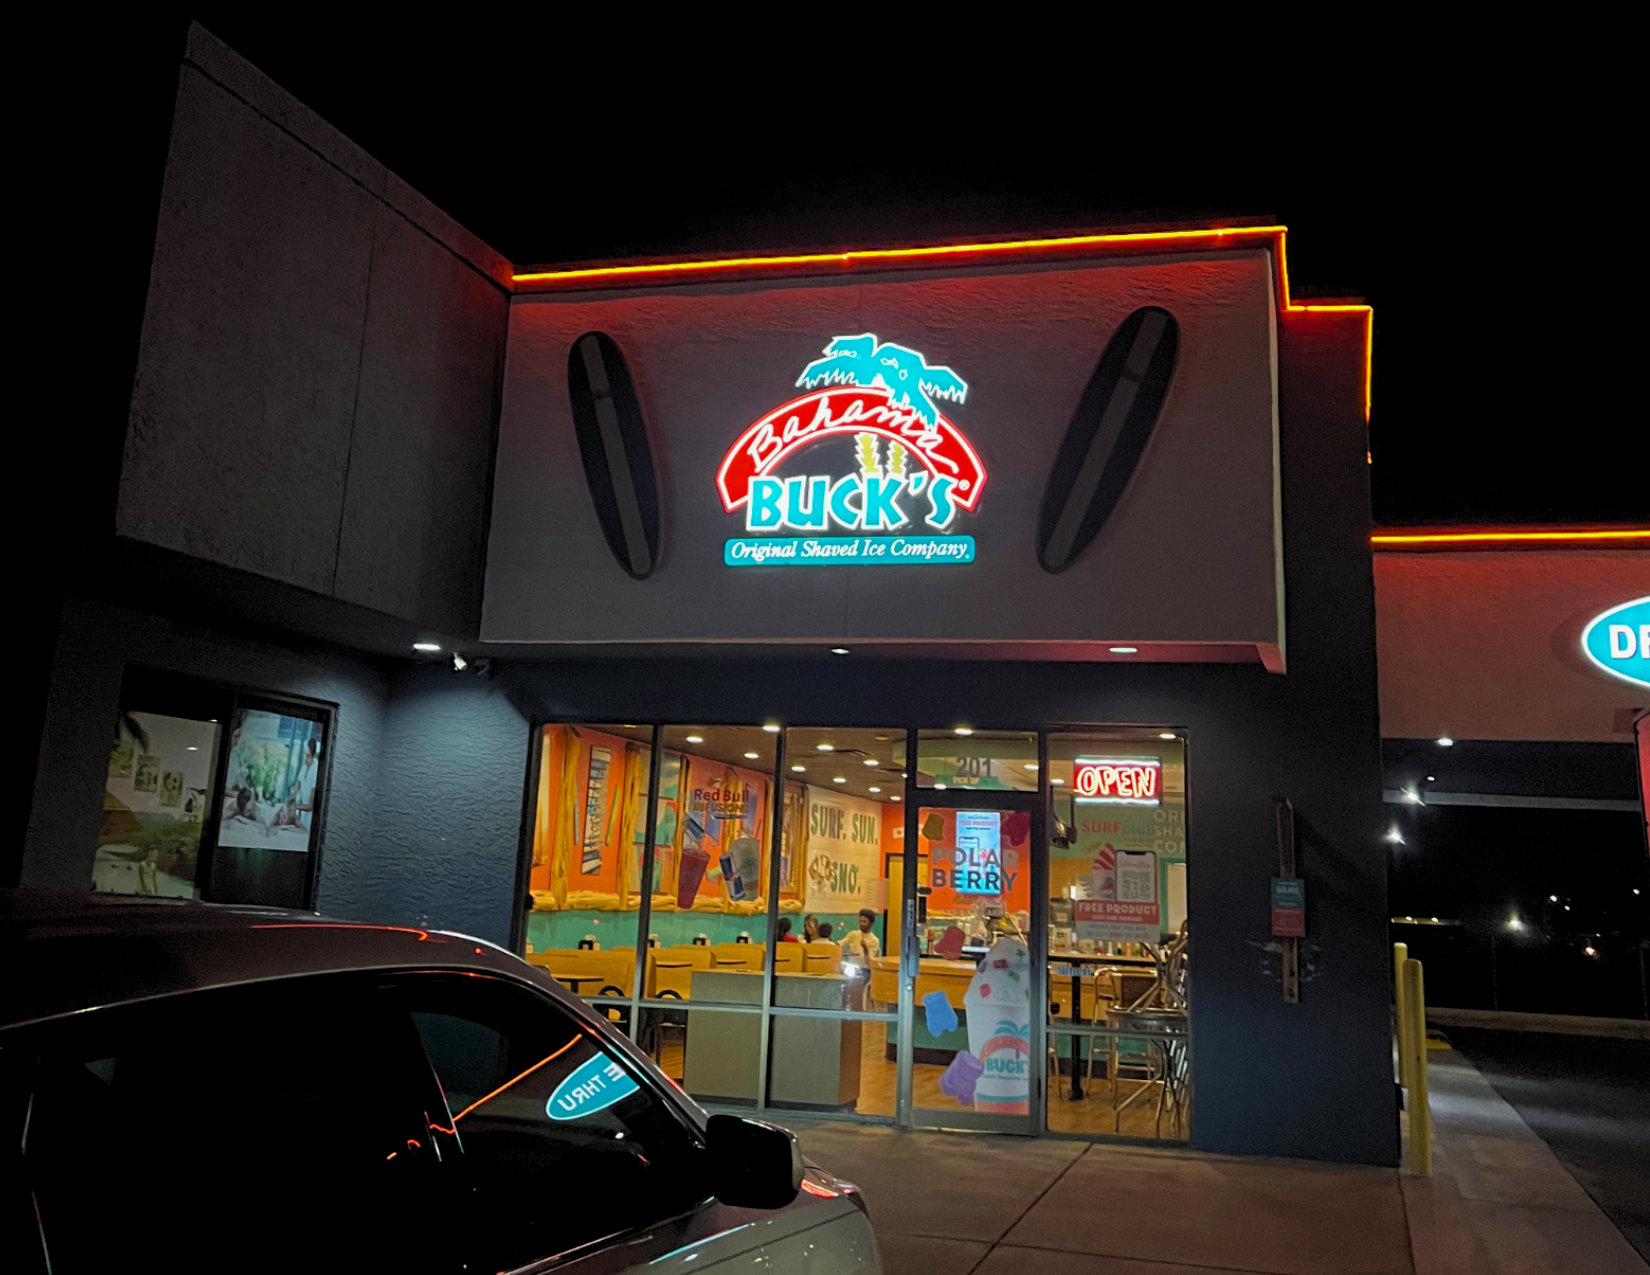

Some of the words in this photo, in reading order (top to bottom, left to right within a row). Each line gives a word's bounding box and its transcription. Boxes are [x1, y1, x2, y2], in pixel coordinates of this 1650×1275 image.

[747, 396, 960, 474] Bahama
[747, 472, 957, 530] BUCK'S
[731, 541, 797, 562] Original
[801, 540, 858, 557] Shaved
[861, 540, 885, 556] Ice
[891, 539, 967, 560] Company
[956, 756, 991, 778] 201
[1077, 765, 1156, 798] OPEN
[694, 788, 719, 801] Red
[723, 789, 749, 802] Bull
[810, 803, 846, 840] SURF.
[851, 813, 878, 845] SUN.
[1081, 821, 1120, 834] SURF
[932, 846, 1019, 869] POLAR
[830, 861, 861, 894] SNO.
[932, 869, 1018, 892] BERRY
[1078, 902, 1105, 913] FREE
[1106, 903, 1158, 916] PRODUCT
